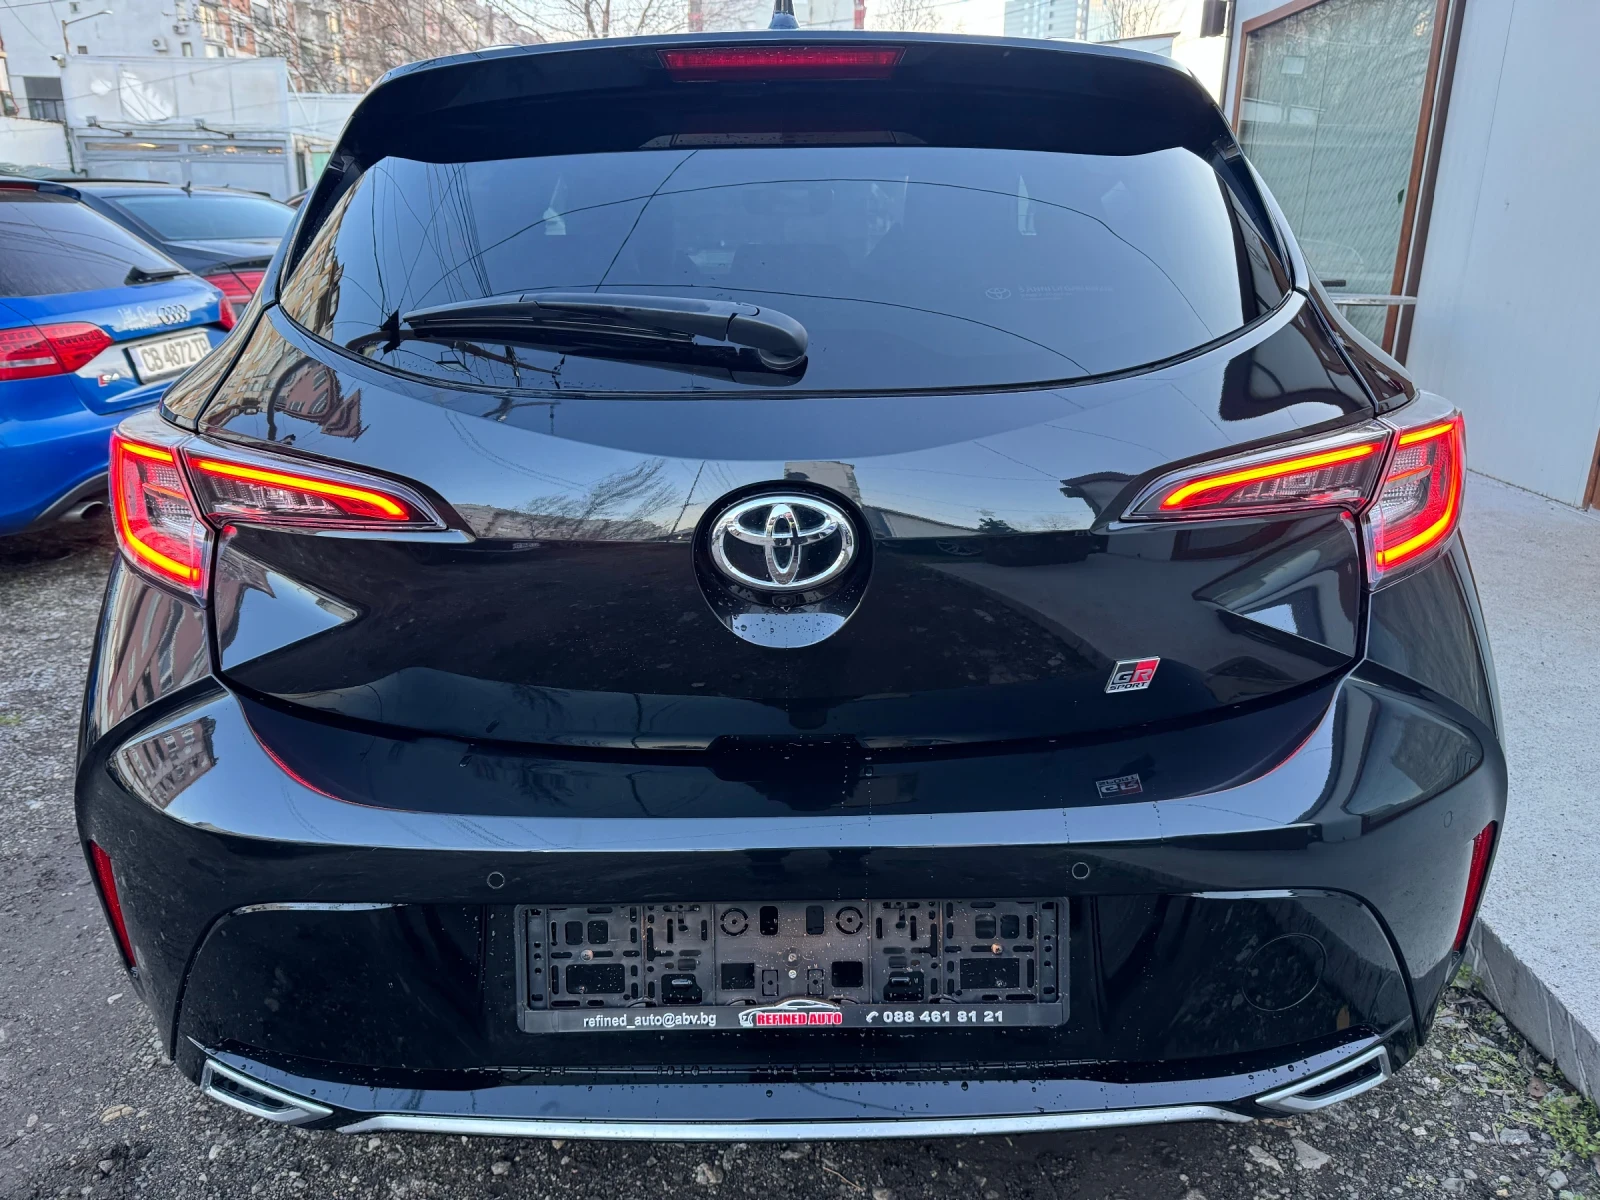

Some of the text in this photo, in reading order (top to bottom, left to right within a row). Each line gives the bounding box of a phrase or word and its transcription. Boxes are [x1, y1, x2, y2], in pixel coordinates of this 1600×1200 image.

[163, 340, 196, 368] 4872
[1114, 669, 1153, 683] GR
[1110, 682, 1148, 690] SPORT
[583, 1012, 717, 1029] refined_auto@abv.bg
[756, 1011, 843, 1026] REFINED AUTO
[882, 1010, 1004, 1023] 088 461 81 21
